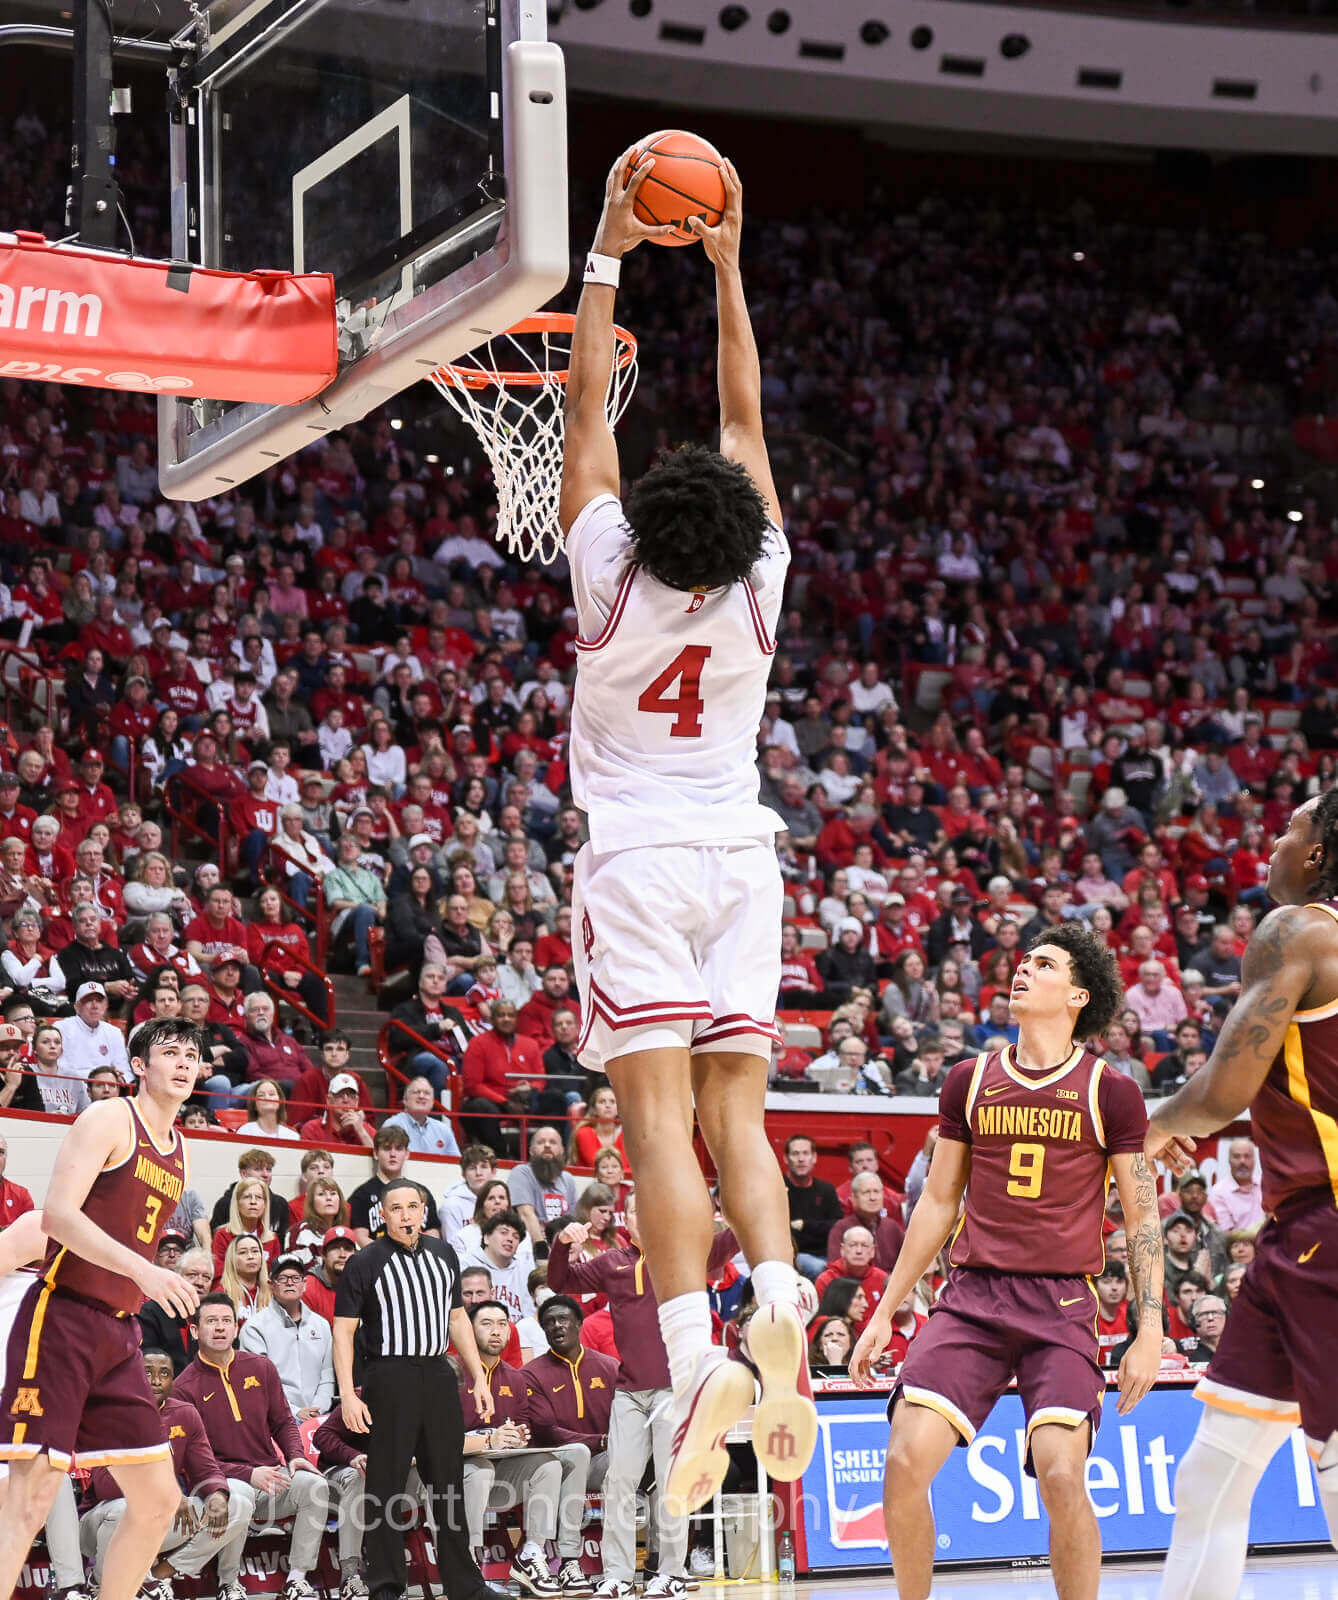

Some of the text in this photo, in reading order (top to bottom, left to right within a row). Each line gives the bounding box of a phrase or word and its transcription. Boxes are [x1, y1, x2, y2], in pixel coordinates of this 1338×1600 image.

[638, 645, 712, 738] 4
[978, 1106, 1082, 1141] MINNESOTA
[134, 1154, 183, 1203] MINNESOTA
[1007, 1143, 1046, 1198] 9
[136, 1194, 162, 1244] 3
